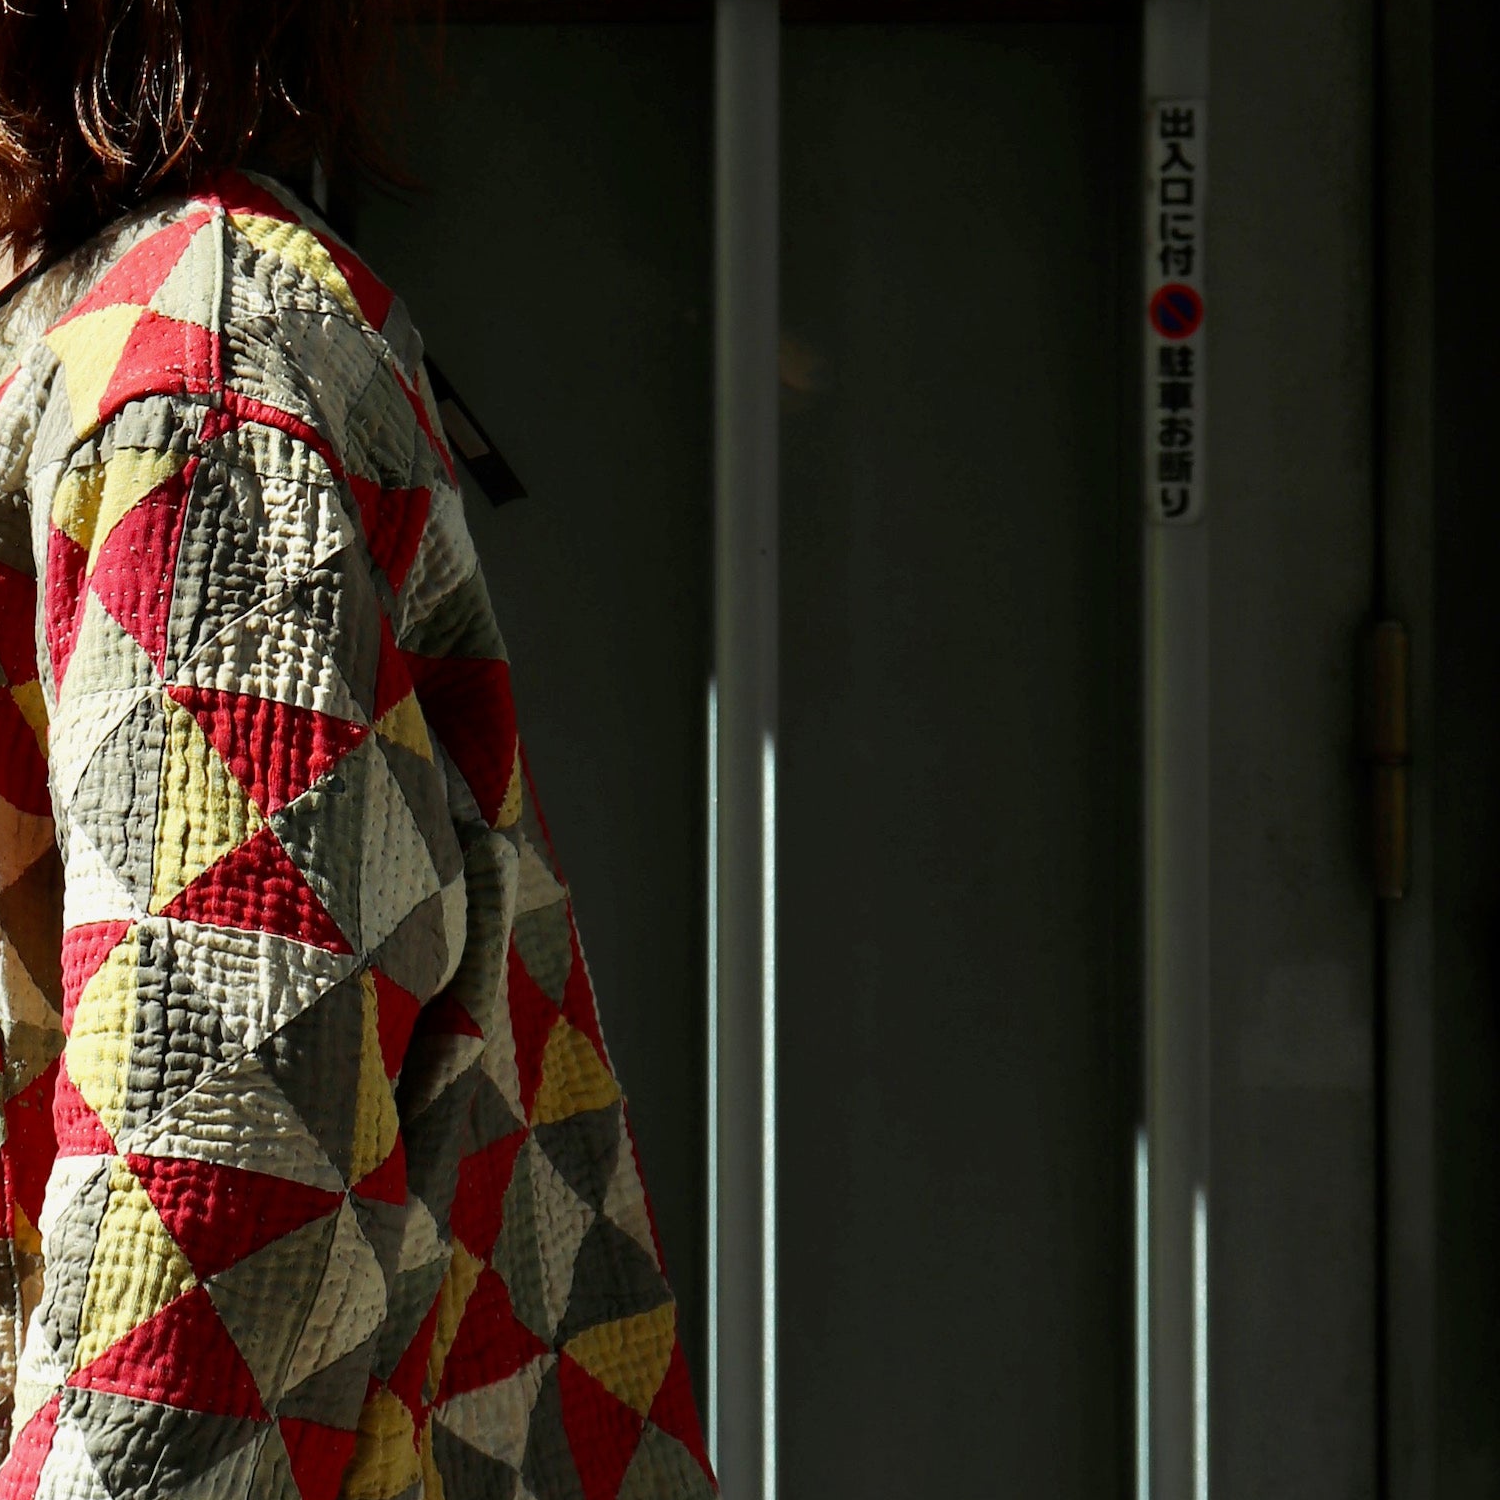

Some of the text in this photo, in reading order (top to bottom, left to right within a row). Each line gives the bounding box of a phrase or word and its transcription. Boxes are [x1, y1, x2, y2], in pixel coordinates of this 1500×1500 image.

[1157, 108, 1195, 518] 出入口に付 駐車お断り
